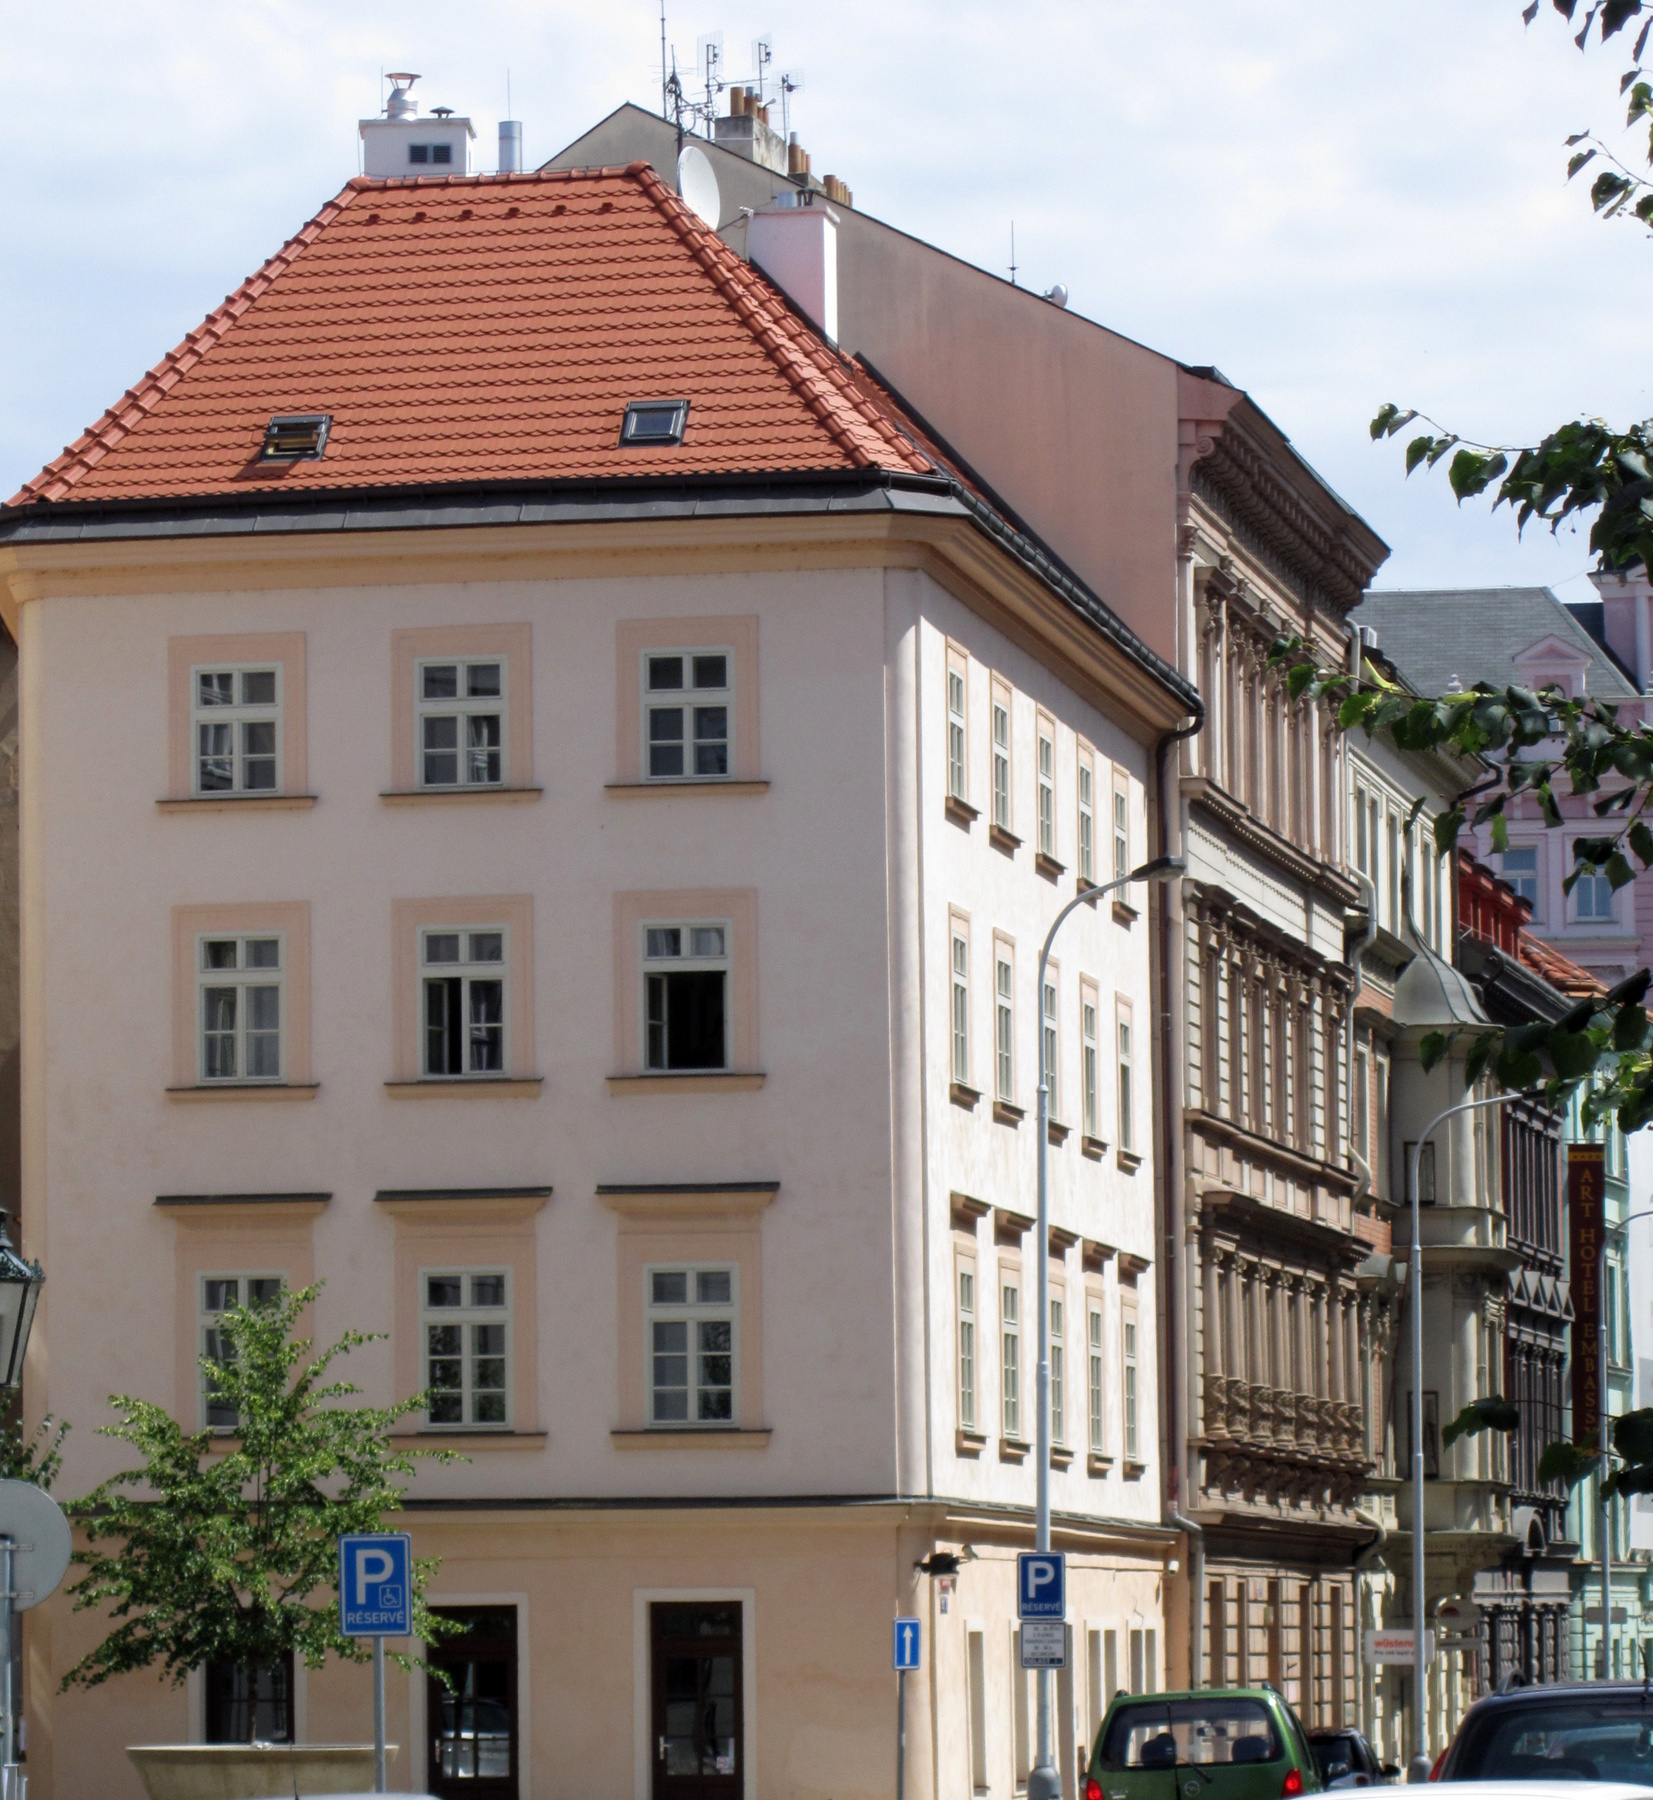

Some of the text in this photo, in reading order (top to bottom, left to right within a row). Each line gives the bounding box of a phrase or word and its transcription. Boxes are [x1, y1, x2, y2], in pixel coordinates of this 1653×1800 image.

[1580, 1168, 1594, 1217] ART
[1580, 1229, 1596, 1312] HOTEL
[356, 1549, 394, 1605] P
[1028, 1561, 1055, 1599] P
[347, 1610, 406, 1625] RÉSERVÉ
[1022, 1601, 1061, 1612] RÉSERVÉ
